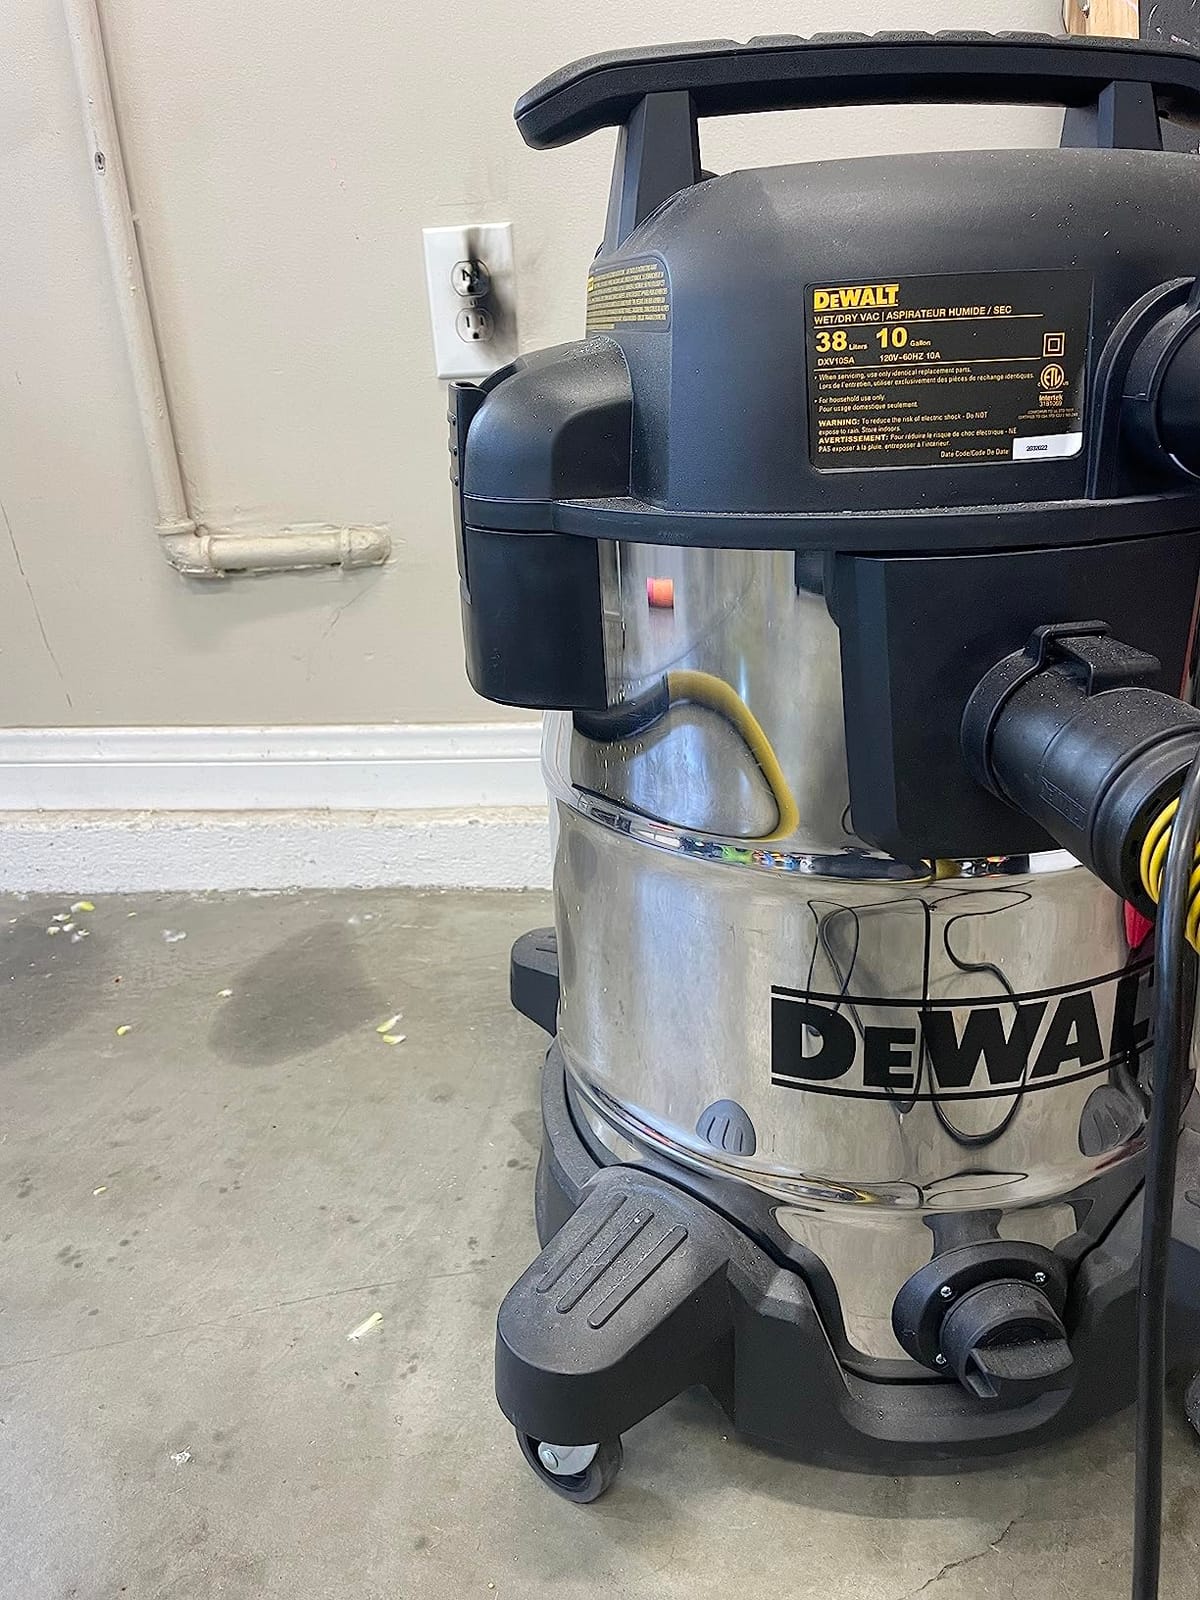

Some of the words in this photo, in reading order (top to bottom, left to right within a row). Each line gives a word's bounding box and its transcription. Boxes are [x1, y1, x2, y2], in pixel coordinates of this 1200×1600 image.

[814, 286, 899, 310] DEWALT
[814, 313, 860, 325] WET/DRY
[860, 312, 880, 321] VAC
[886, 308, 946, 321] ASPIRATEUR
[948, 306, 986, 317] HUMIDE
[993, 304, 1012, 315] SEC
[815, 330, 849, 353] 38
[848, 342, 868, 351] Liters
[875, 326, 908, 349] 10
[909, 339, 931, 347] Gallon
[817, 356, 855, 367] DXV10SA
[925, 351, 941, 361] 10A
[878, 370, 891, 379] only
[891, 369, 918, 377] identical
[918, 367, 955, 376] replacement
[819, 381, 832, 390] Lors
[832, 381, 840, 389] de
[894, 377, 936, 385] exclusivement
[977, 373, 1004, 381] rechange
[818, 396, 828, 404] For
[829, 395, 859, 403] household
[833, 404, 851, 412] usage
[852, 403, 886, 411] domestique
[818, 418, 860, 427] WARNING:
[861, 417, 870, 425] To
[914, 414, 921, 422] of
[921, 413, 943, 421] electric
[944, 412, 961, 420] shock
[974, 411, 988, 419] NOT
[818, 428, 839, 436] expose
[818, 433, 889, 444] AVERTISSEMENT:
[933, 431, 951, 439] risque
[952, 430, 960, 438] de
[961, 429, 975, 437] choc
[1008, 426, 1017, 434] NE
[818, 445, 831, 453] PAS
[861, 443, 867, 451] la
[884, 442, 916, 450] entreposer
[940, 450, 954, 458] Date
[955, 449, 985, 457] Code/Code
[986, 448, 995, 456] De
[995, 447, 1009, 455] Date
[771, 966, 1154, 1088] DEWAL
